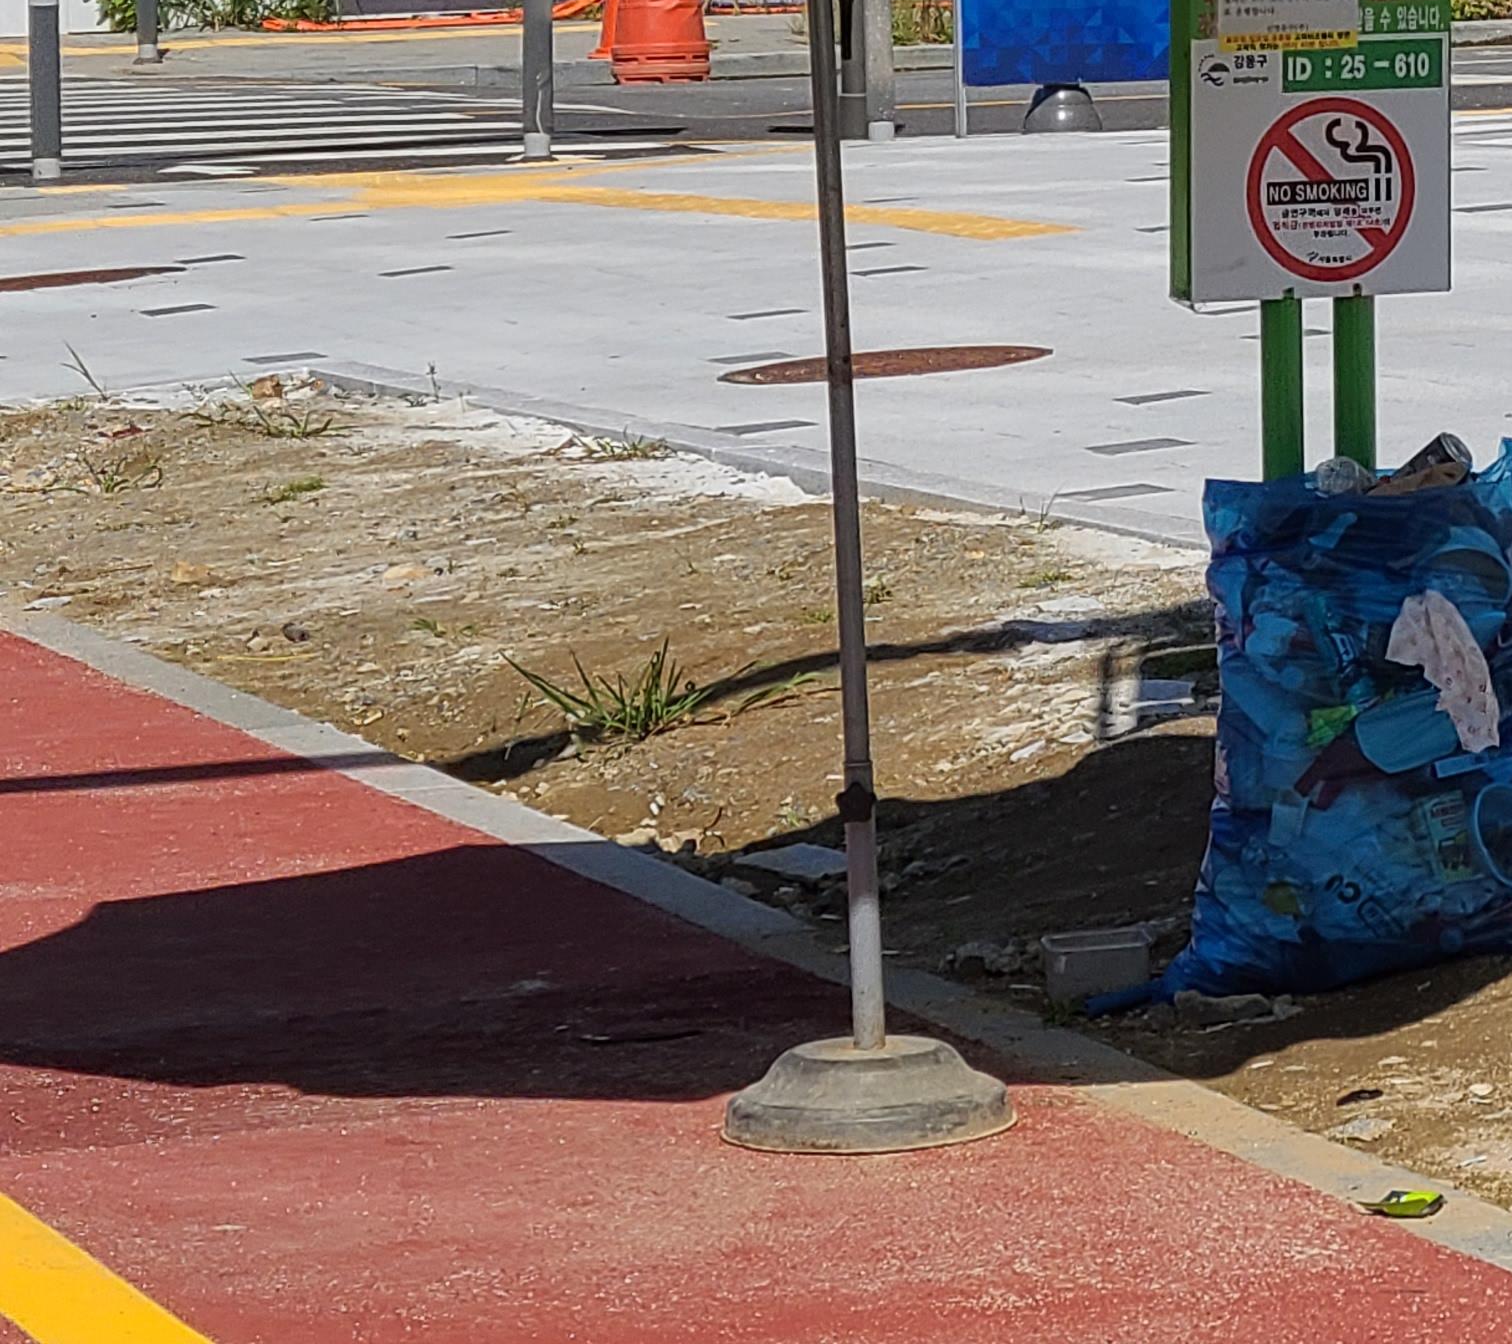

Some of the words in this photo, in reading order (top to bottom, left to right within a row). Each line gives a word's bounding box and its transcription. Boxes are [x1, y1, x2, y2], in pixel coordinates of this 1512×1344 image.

[1380, 6, 1391, 32] 수
[1233, 54, 1268, 69] 강동구
[1287, 56, 1313, 81] ID
[1340, 55, 1366, 80] 25
[1394, 52, 1430, 79] 610
[1268, 184, 1292, 203] NO
[1295, 181, 1368, 201] SMOKING
